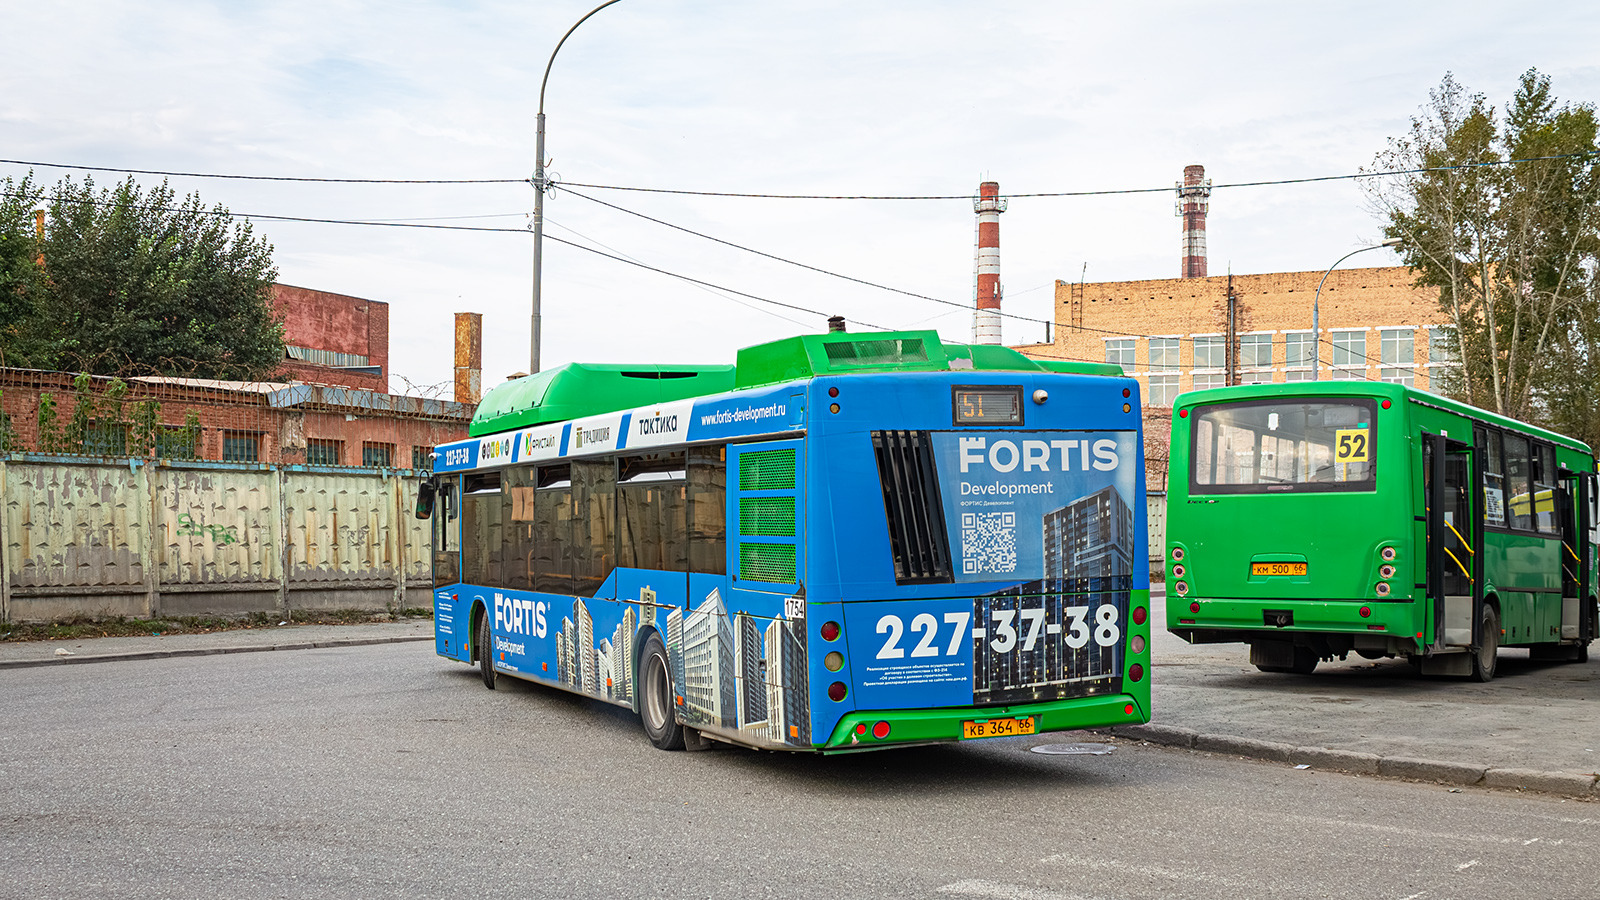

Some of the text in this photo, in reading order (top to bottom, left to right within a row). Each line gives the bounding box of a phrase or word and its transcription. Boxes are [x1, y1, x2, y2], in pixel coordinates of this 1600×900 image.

[701, 404, 786, 426] www.fortis-development.ru
[963, 393, 984, 417] 51
[583, 427, 610, 444] ТРАДИЦИЯ
[959, 437, 1119, 473] FORTIS
[1338, 434, 1366, 458] 52
[446, 447, 469, 466] 227-37-38
[960, 481, 1054, 497] Development
[1272, 565, 1289, 574] 500
[1294, 564, 1303, 572] 66
[494, 592, 548, 639] FORTIS
[785, 600, 803, 616] 1754
[875, 603, 1120, 660] 227-37-38
[495, 636, 526, 656] Development
[990, 721, 1012, 735] 364
[1019, 719, 1030, 729] 66
